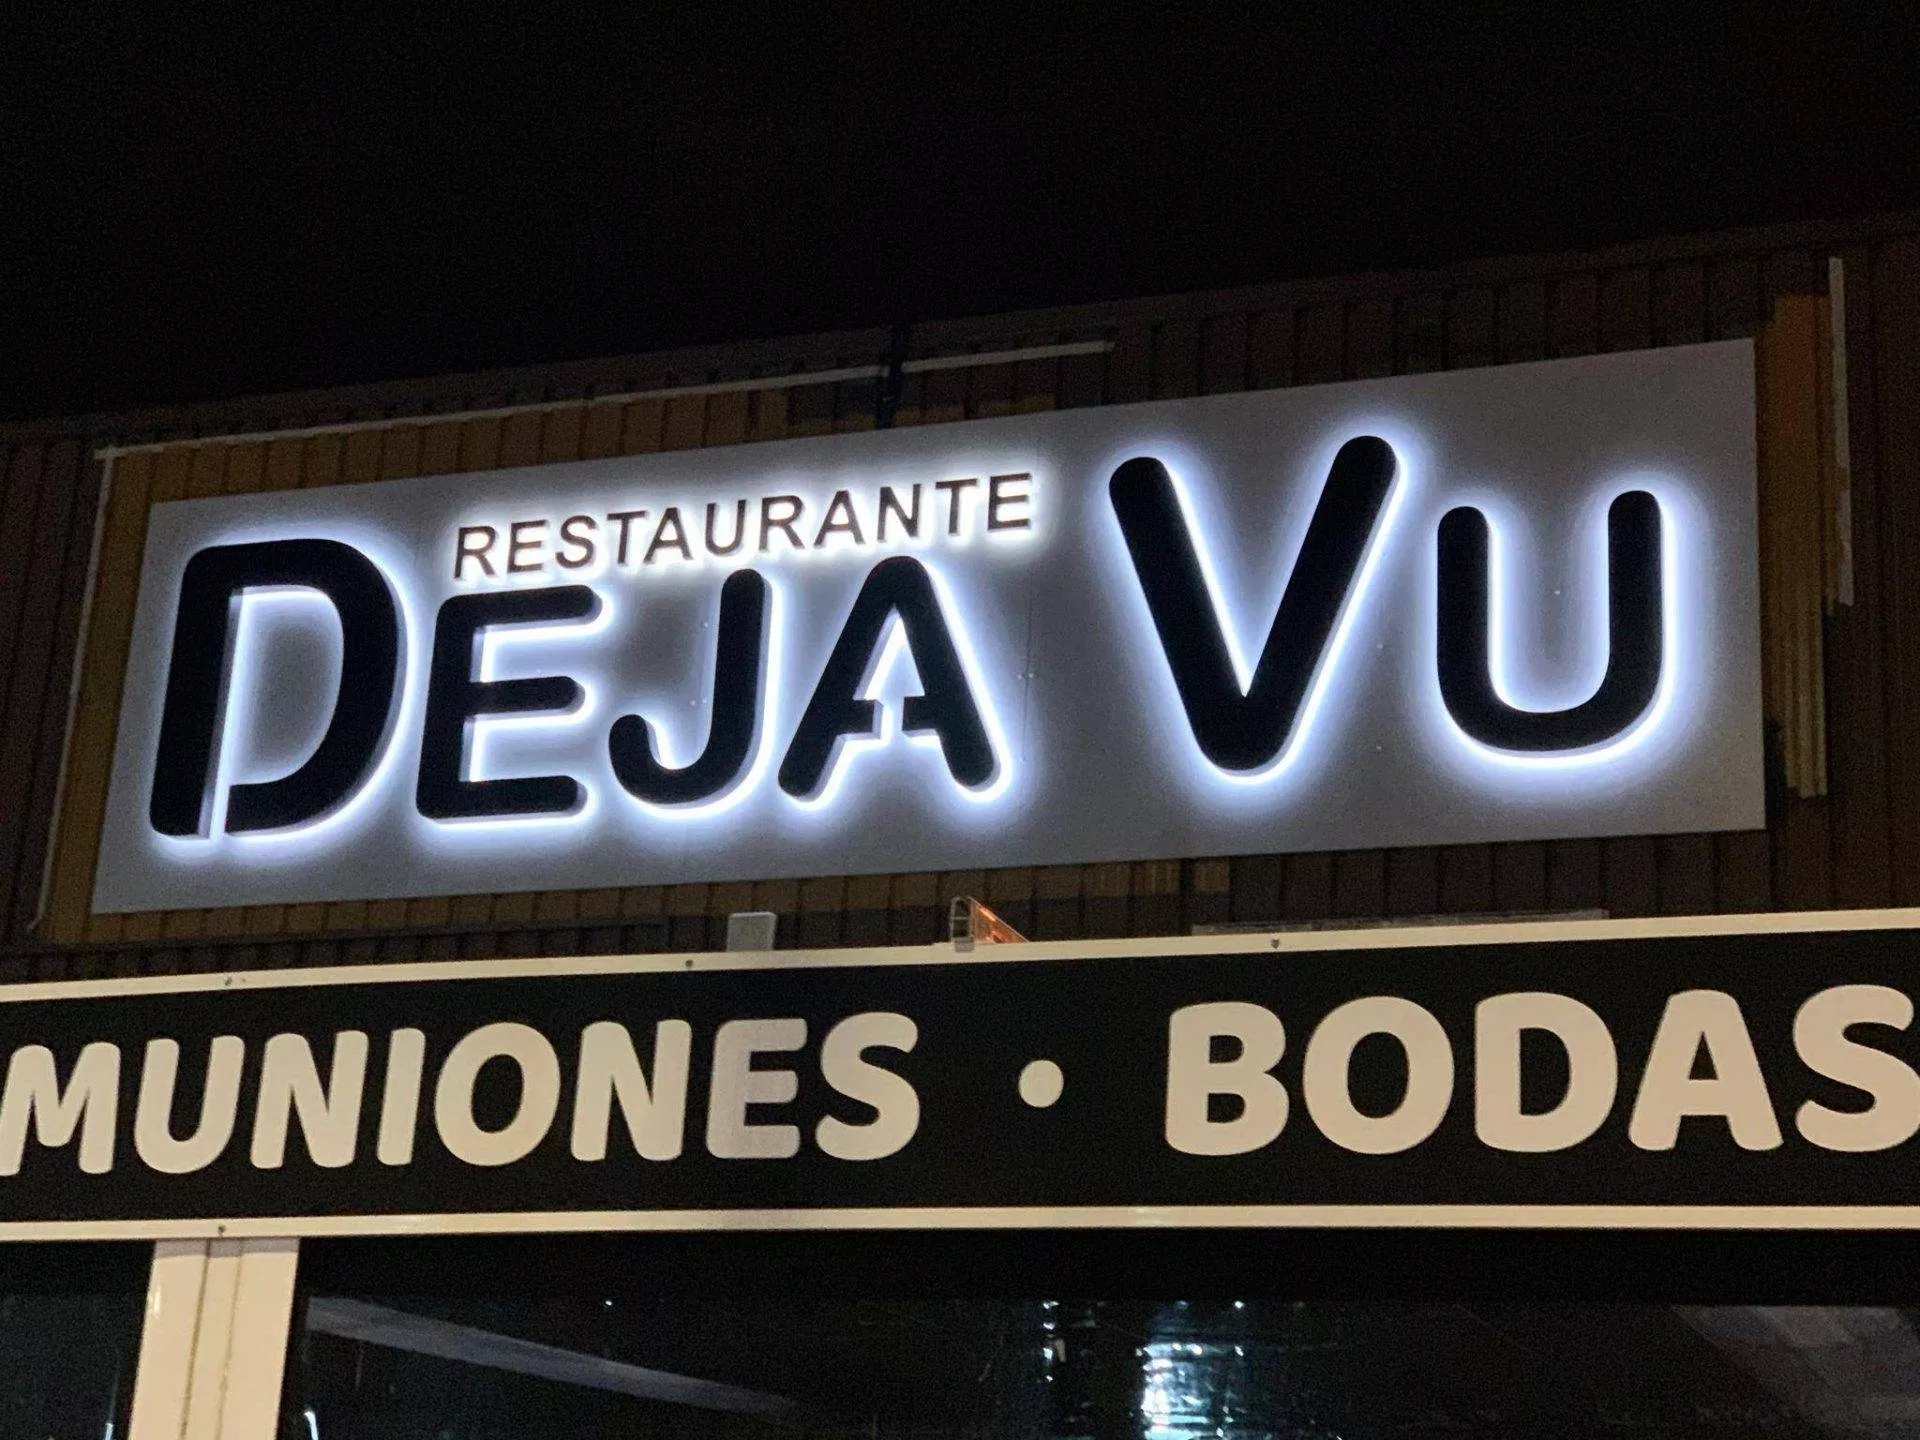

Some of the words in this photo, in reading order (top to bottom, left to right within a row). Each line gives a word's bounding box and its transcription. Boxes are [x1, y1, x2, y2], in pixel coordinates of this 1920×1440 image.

[453, 471, 1034, 580] RESTAURANTE
[149, 536, 1000, 838] DEJA
[0, 1012, 921, 1177] MUNIONES
[1165, 984, 1920, 1156] BODAS
